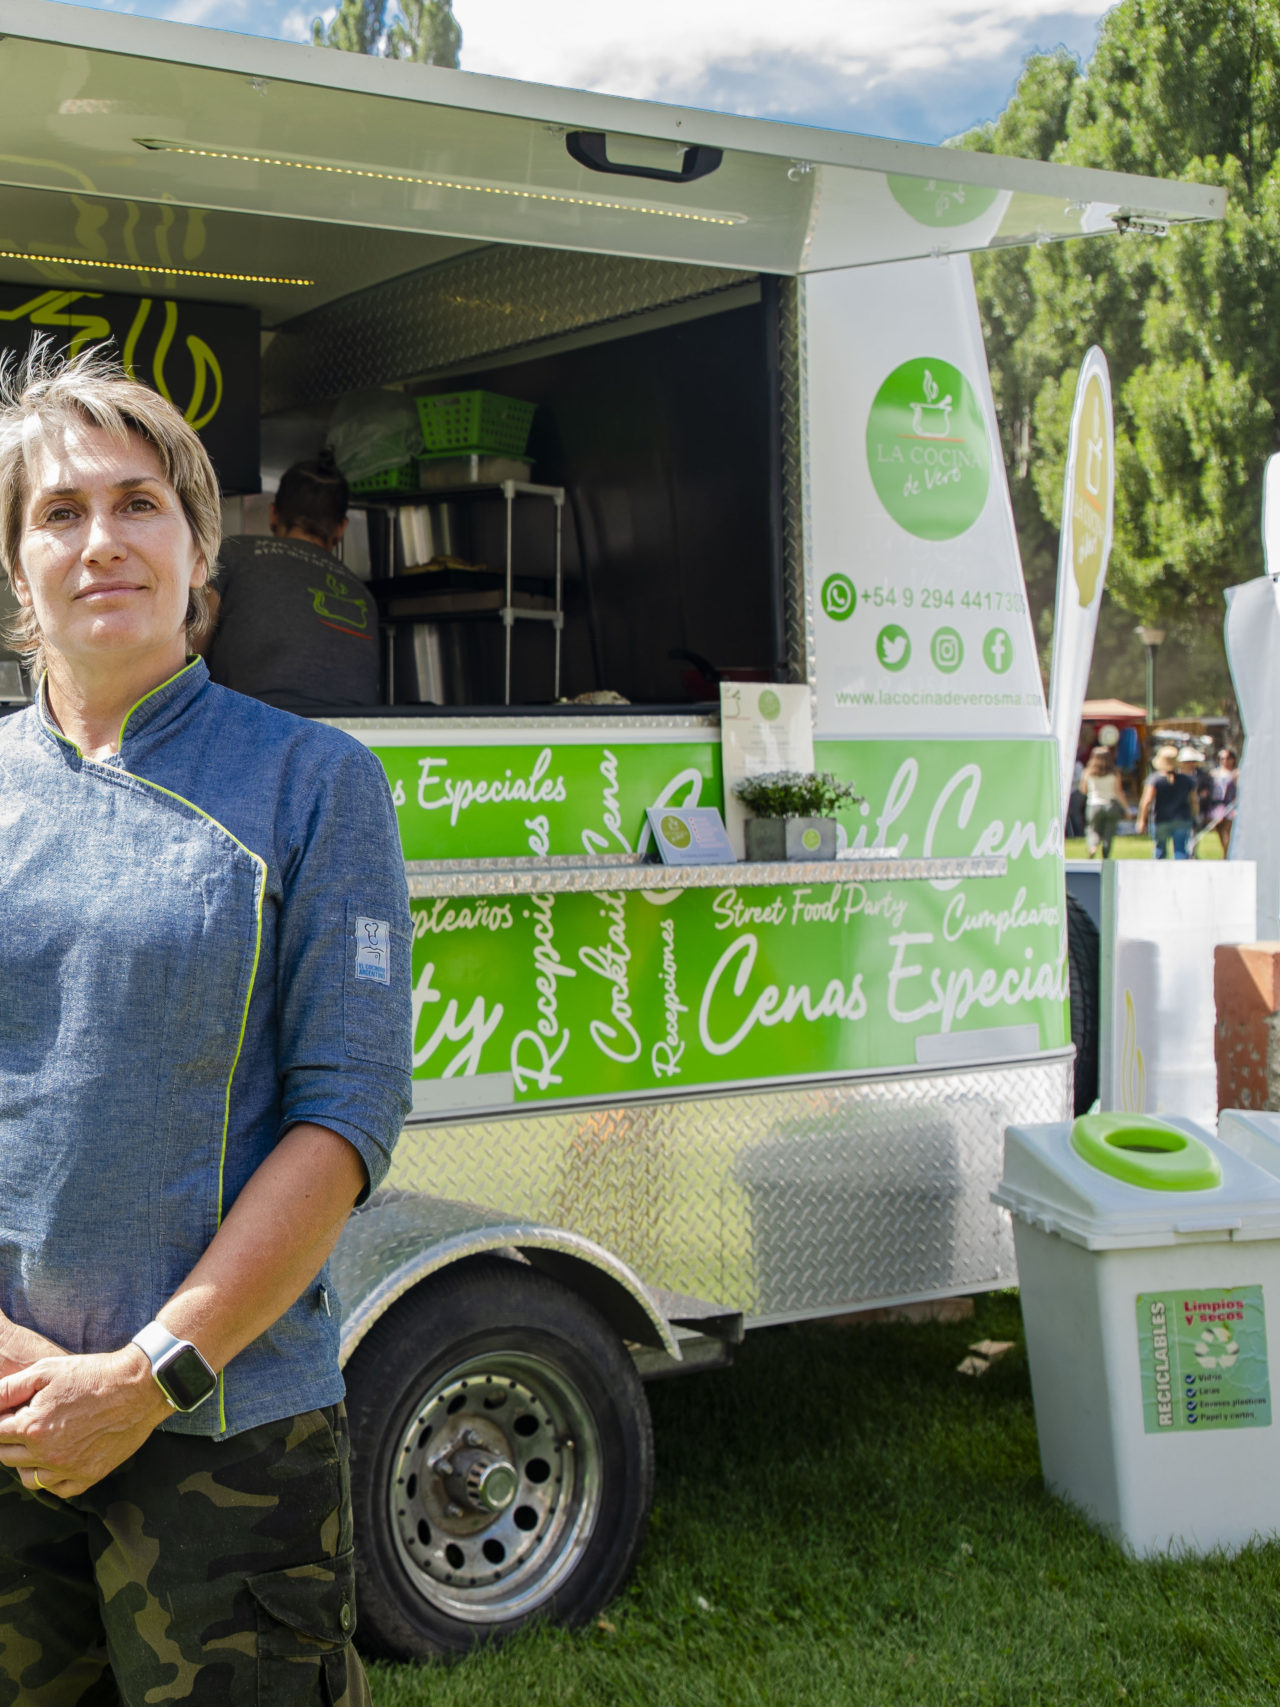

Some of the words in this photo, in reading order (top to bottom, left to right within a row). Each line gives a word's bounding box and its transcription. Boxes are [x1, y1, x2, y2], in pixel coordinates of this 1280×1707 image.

[876, 443, 904, 463] LA
[903, 473, 920, 497] de
[924, 466, 962, 490] Vero
[861, 586, 896, 607] +54
[903, 587, 914, 608] 9
[921, 588, 955, 609] 294
[418, 748, 567, 826] Especiales
[712, 888, 787, 930] Street
[791, 884, 840, 925] Food
[842, 882, 908, 928] Party
[651, 918, 689, 1078] Recepciones
[698, 933, 868, 1055] Cenas
[1184, 1299, 1244, 1313] Limpios
[1199, 1311, 1244, 1323] secos
[1151, 1301, 1173, 1427] RECICLABLES
